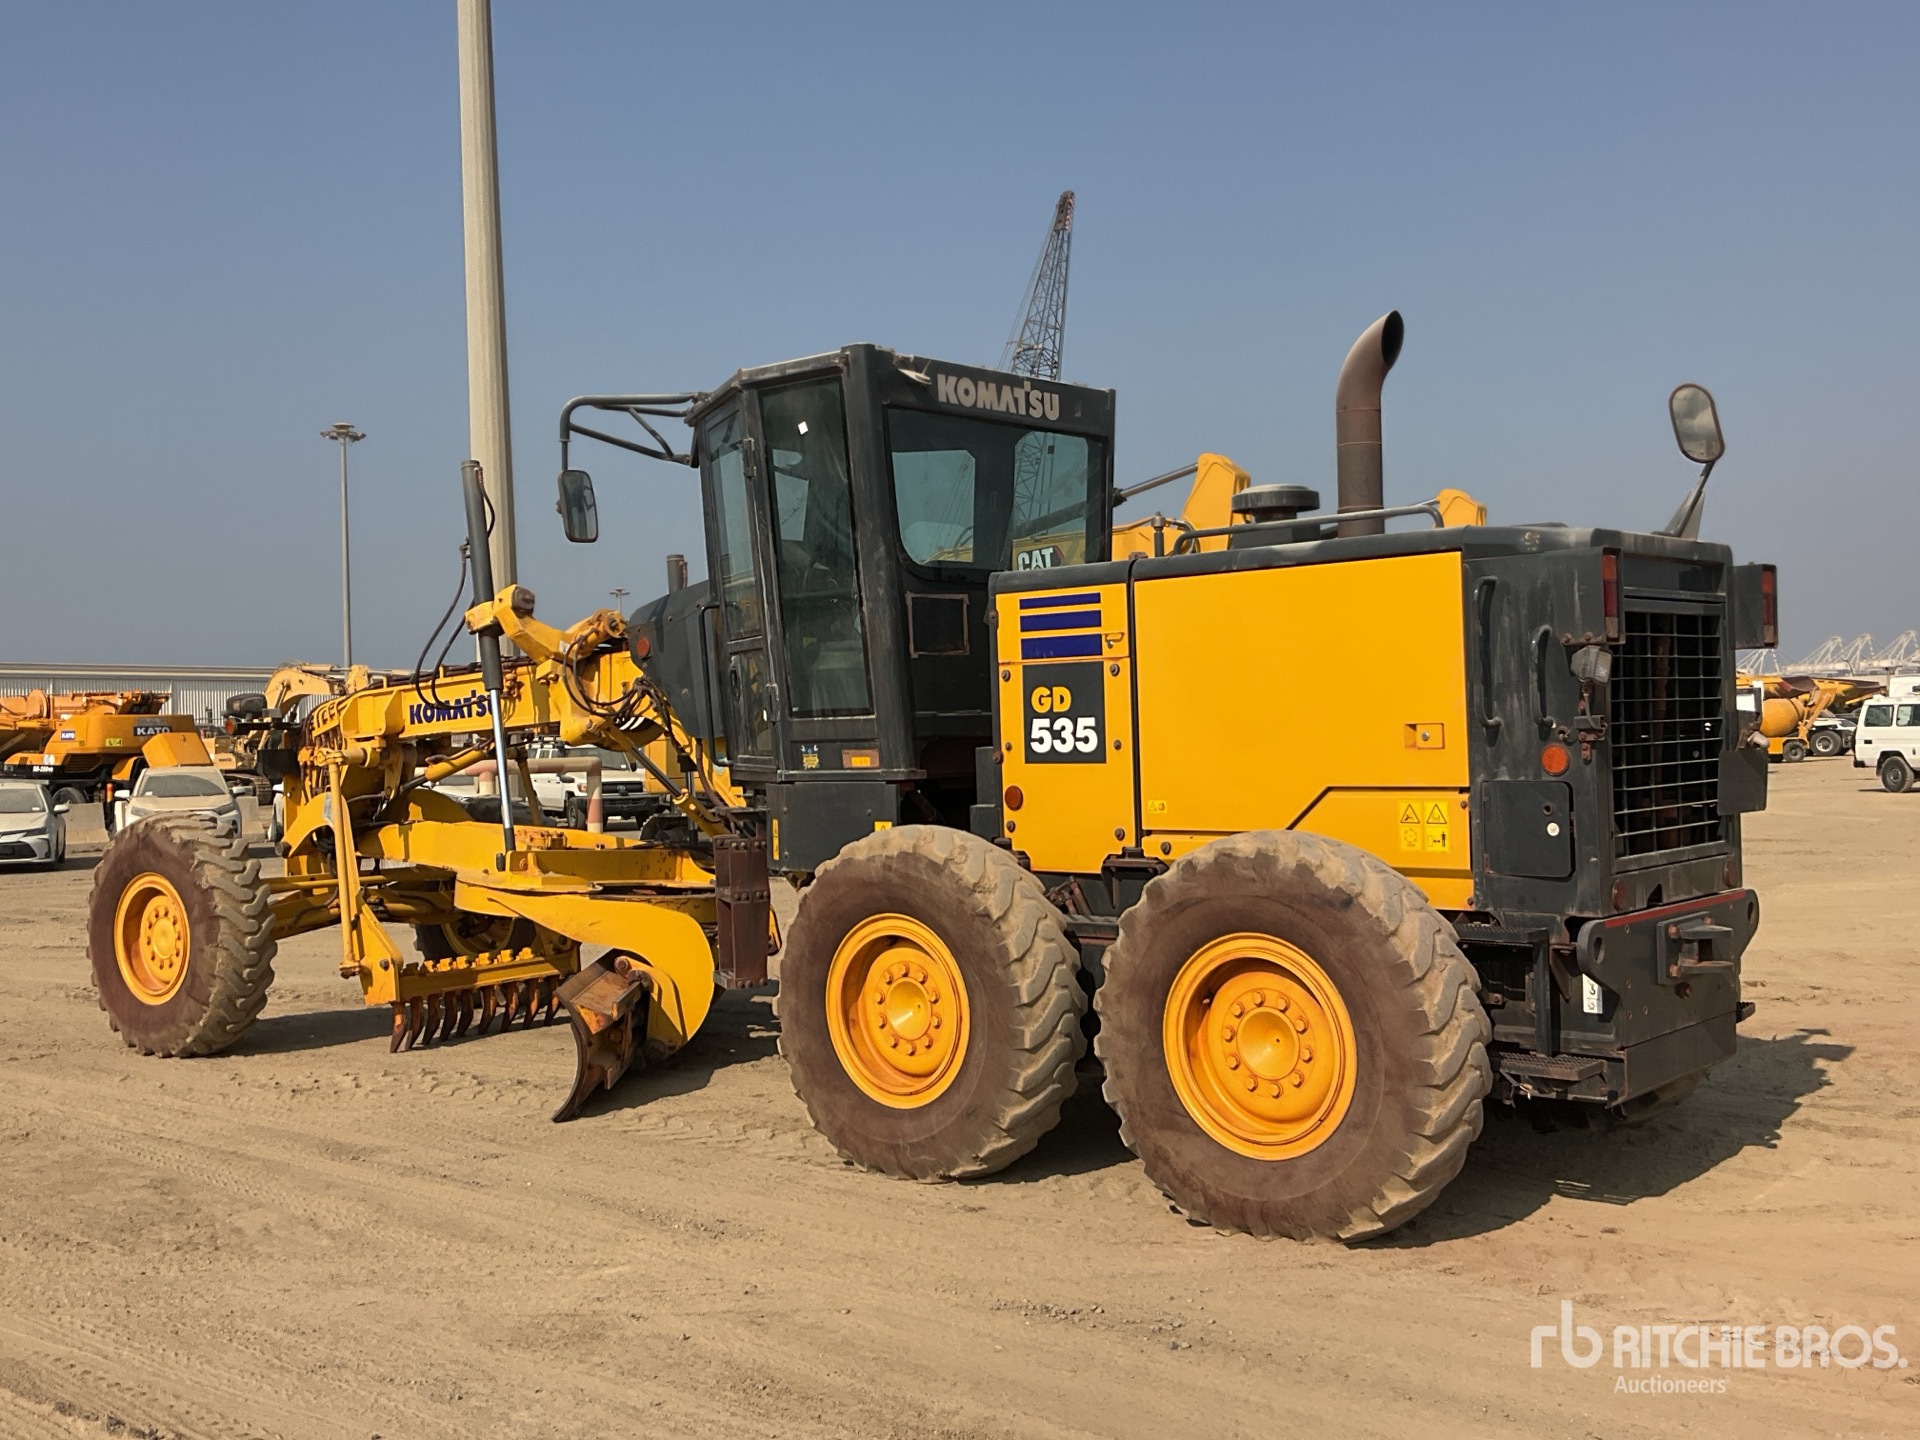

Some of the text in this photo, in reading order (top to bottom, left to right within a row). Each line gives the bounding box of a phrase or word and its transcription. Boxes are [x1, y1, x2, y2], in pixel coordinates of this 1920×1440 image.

[937, 373, 1060, 421] KOMATSU
[1017, 547, 1054, 571] CAT
[1031, 686, 1072, 713] GD
[1030, 716, 1098, 753] 535
